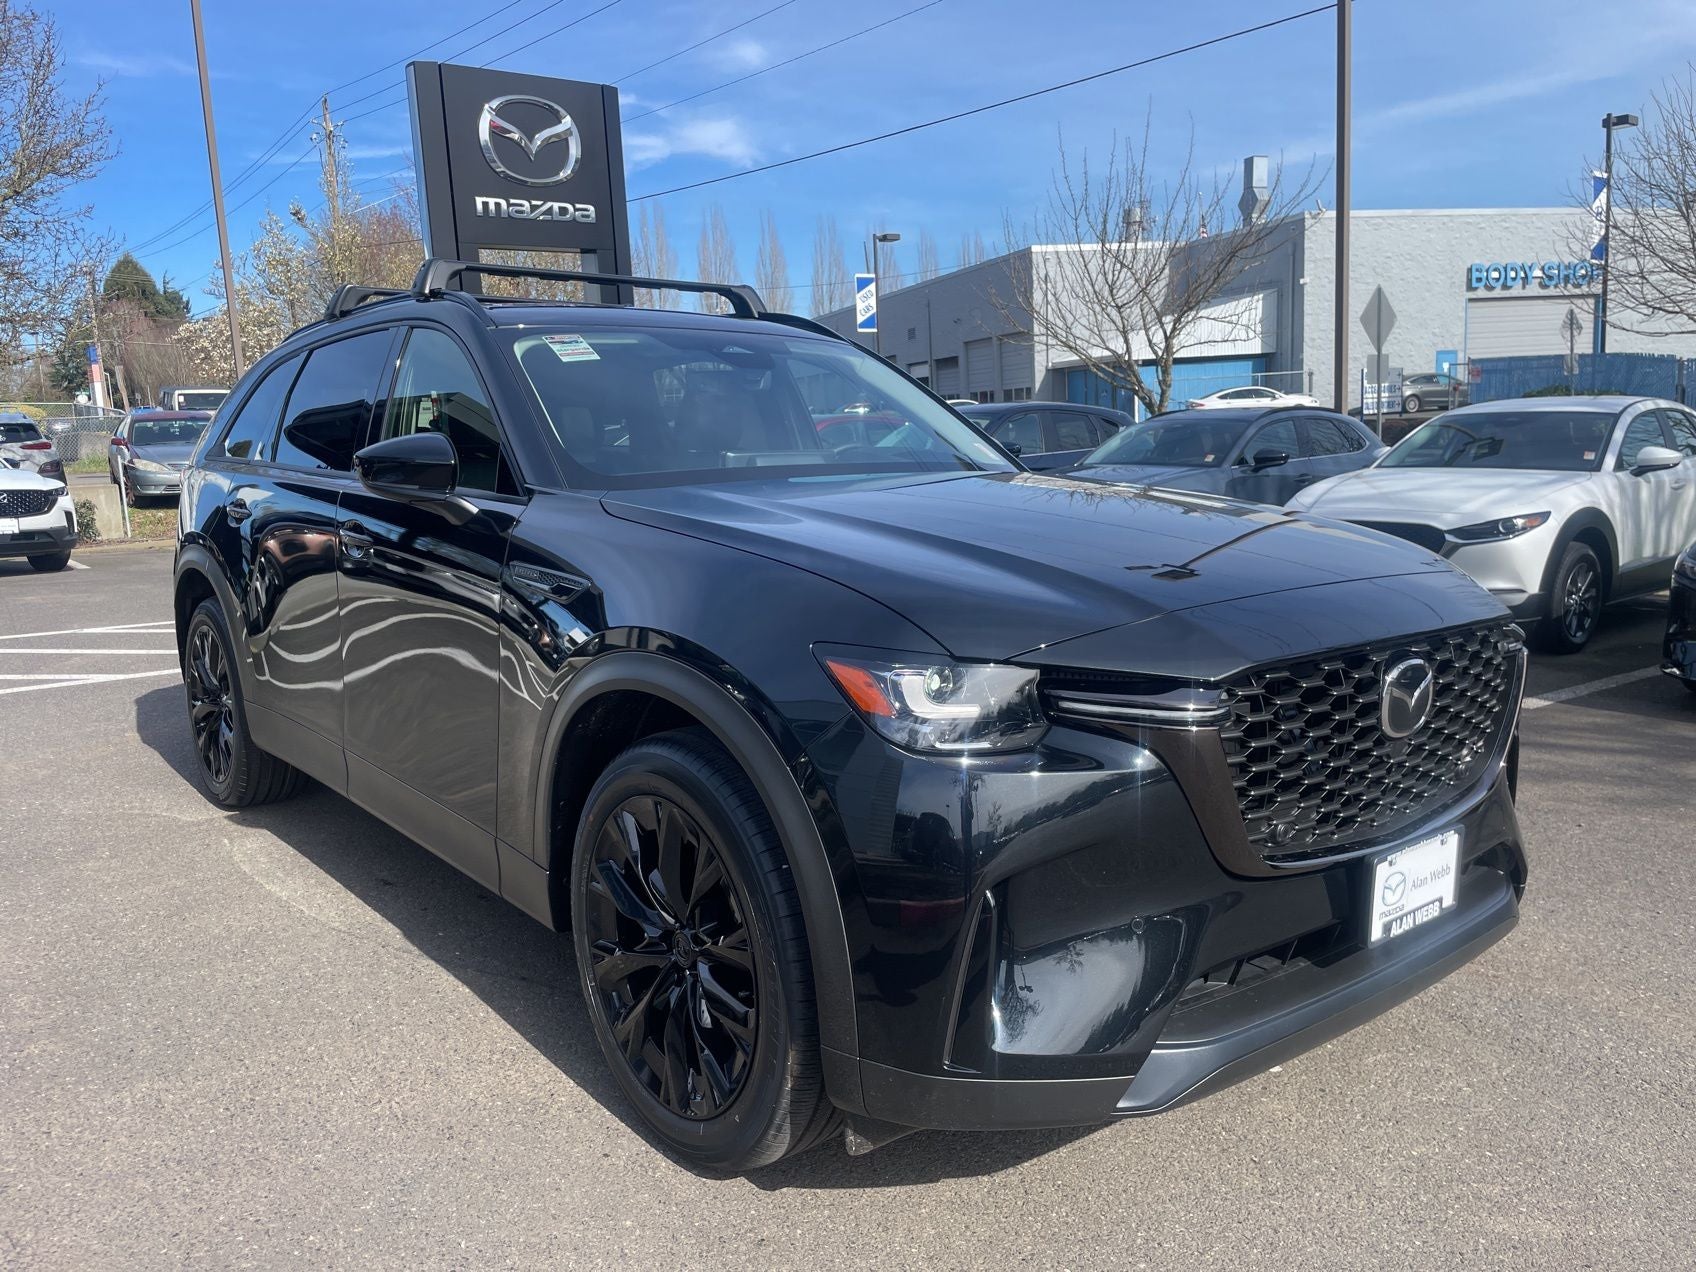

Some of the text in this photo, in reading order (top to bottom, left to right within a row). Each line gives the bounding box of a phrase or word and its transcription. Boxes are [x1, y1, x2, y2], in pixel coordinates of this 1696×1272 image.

[475, 196, 597, 223] mazda
[1471, 262, 1537, 288] BODY
[859, 290, 873, 303] USED
[859, 303, 873, 317] CARS
[1410, 864, 1451, 891] Alan Webb
[1390, 901, 1440, 937] ALAN WEBB
